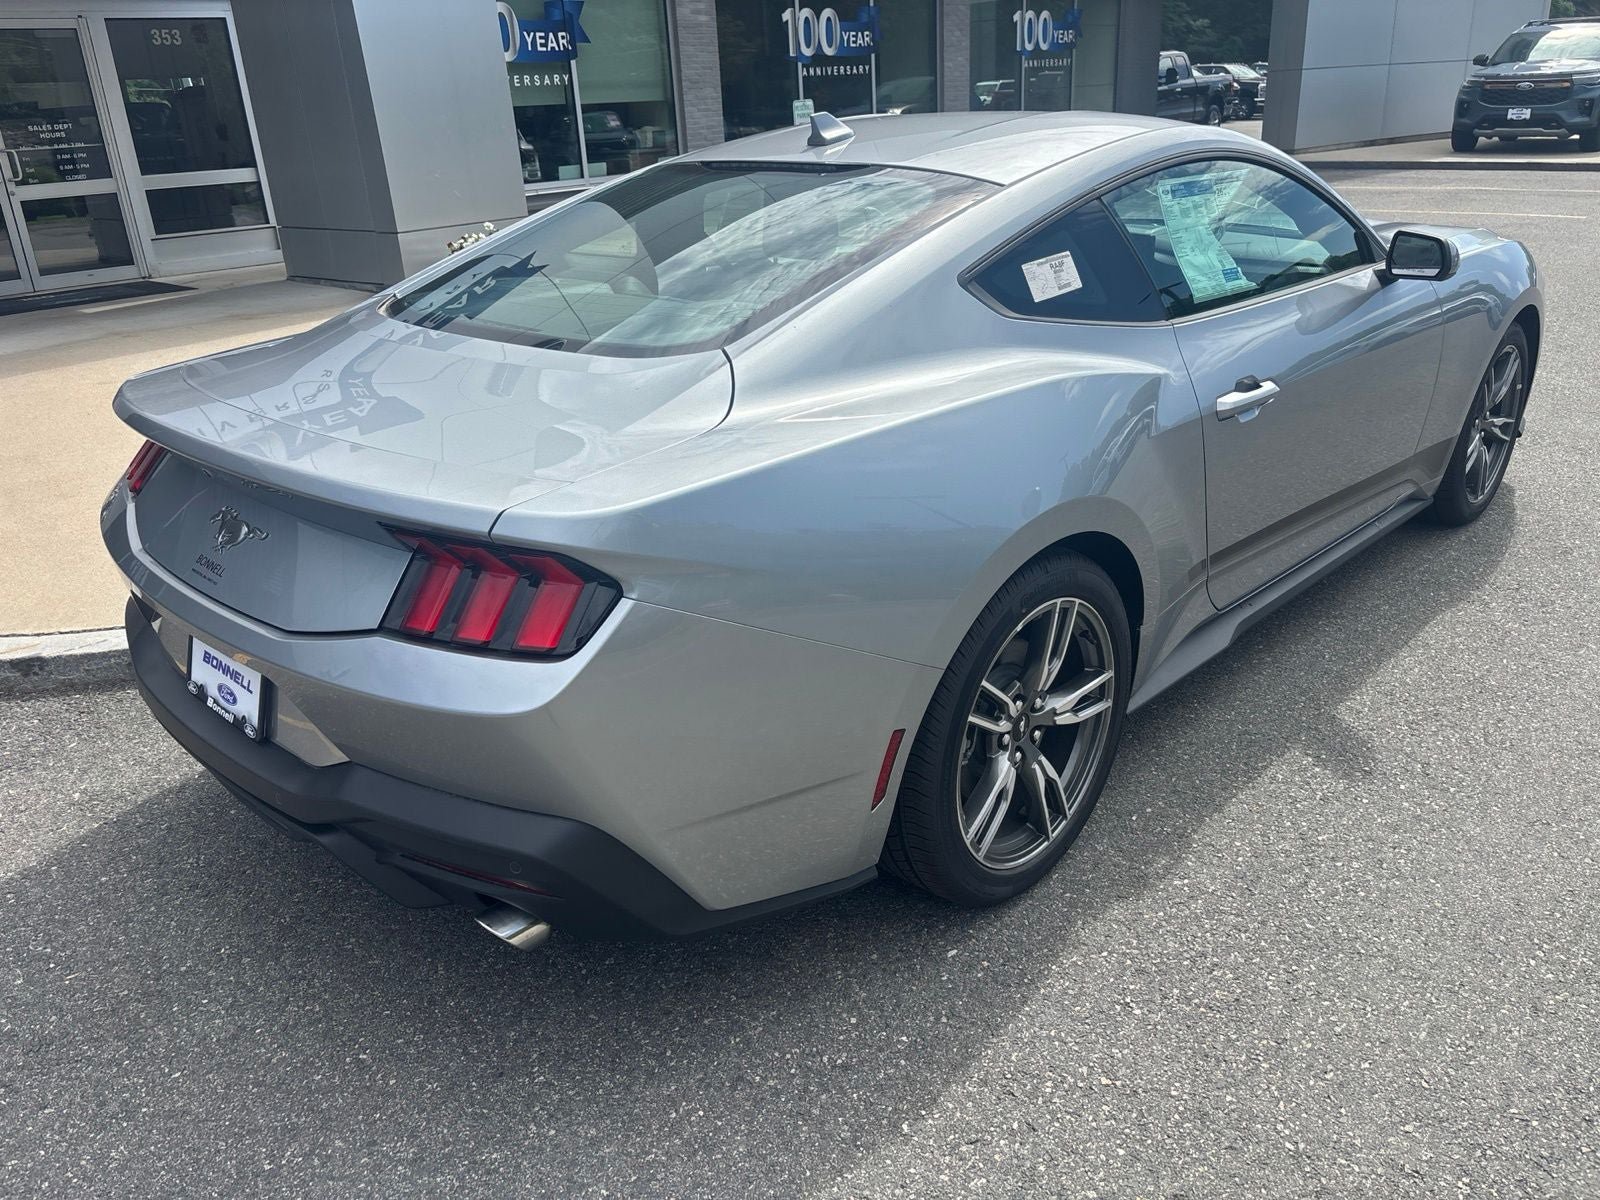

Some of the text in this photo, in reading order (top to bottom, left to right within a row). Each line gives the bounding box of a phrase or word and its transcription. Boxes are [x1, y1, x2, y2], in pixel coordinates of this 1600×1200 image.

[151, 29, 182, 45] 353
[781, 7, 873, 57] 100 YEAR
[1012, 10, 1075, 51] 100 YEAR
[523, 31, 572, 51] YEAR
[802, 65, 870, 76] ANNIVERSARY
[1024, 58, 1071, 67] ANNIVERSARY
[507, 74, 569, 87] ERSARY
[28, 124, 52, 132] SALES
[40, 131, 66, 139] HOURS
[196, 553, 226, 578] BONNELL
[202, 649, 253, 695] BONNELL
[218, 685, 237, 705] Ford
[206, 696, 235, 724] Bonnell
